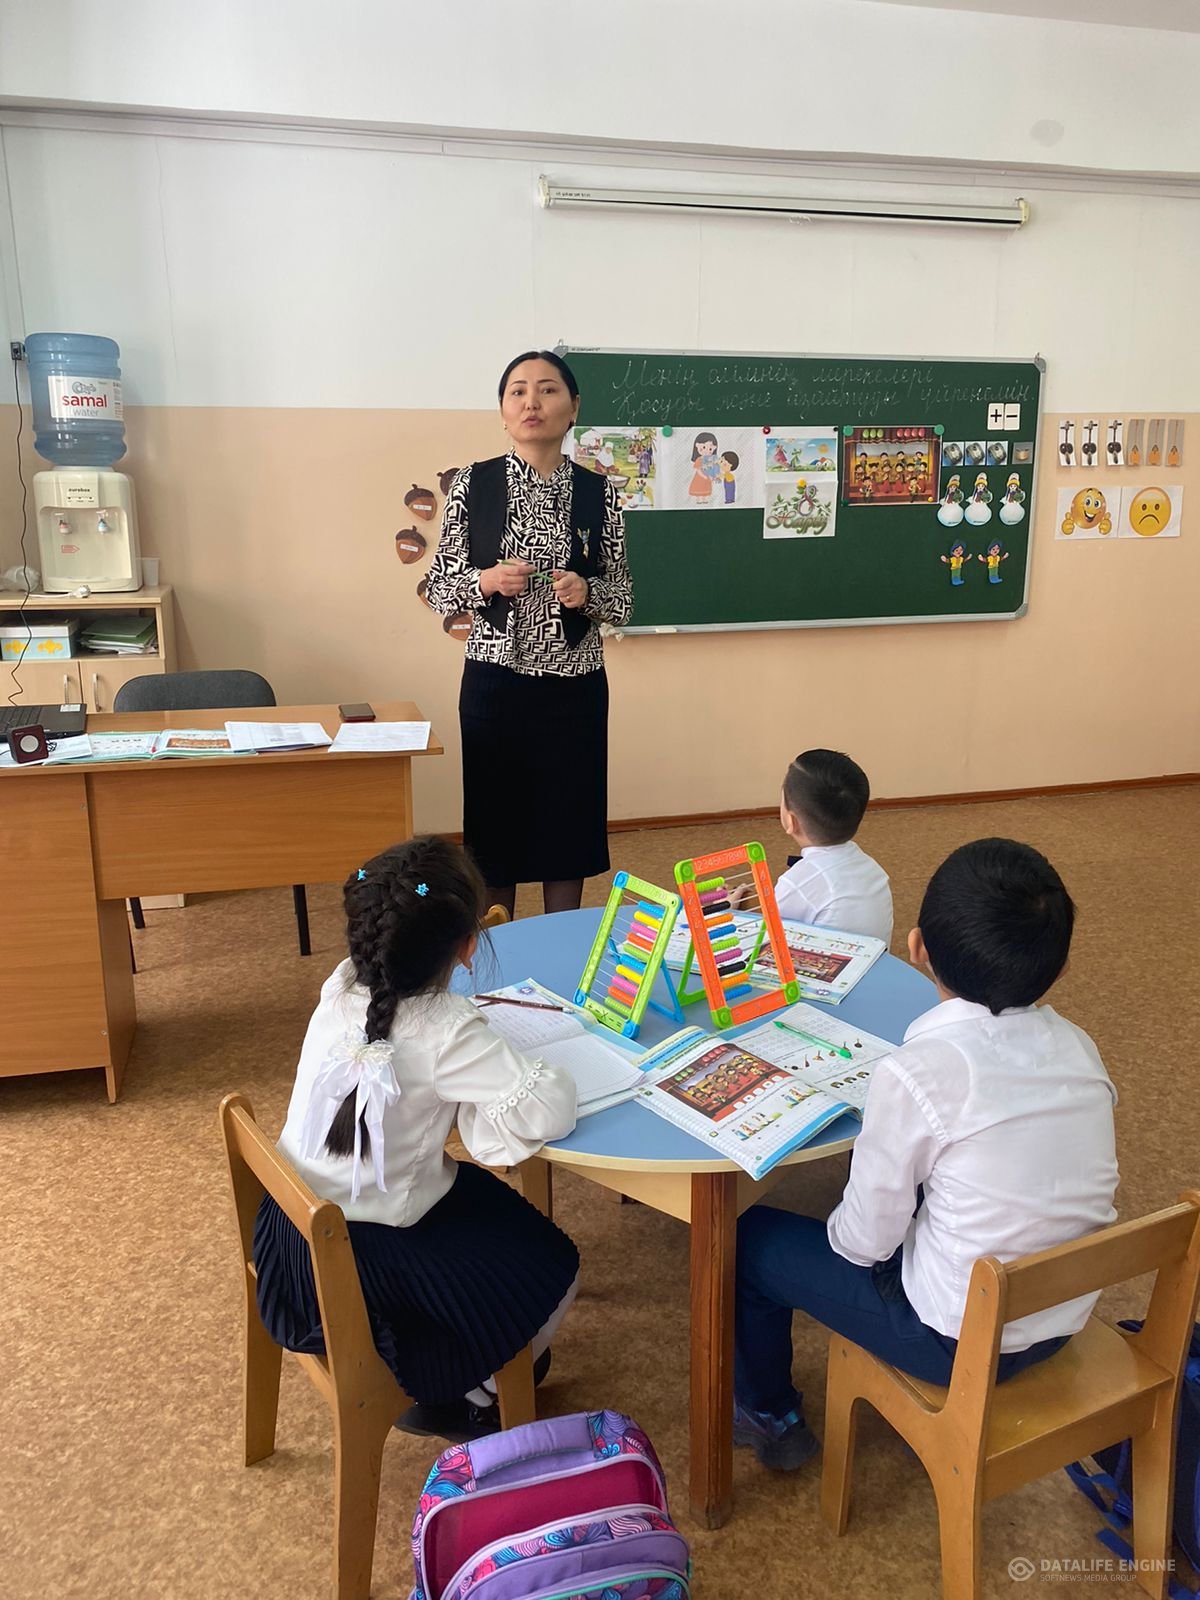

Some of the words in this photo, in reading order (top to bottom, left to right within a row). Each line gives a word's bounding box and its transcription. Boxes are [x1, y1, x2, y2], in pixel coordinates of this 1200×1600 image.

[612, 360, 699, 395] Менің
[62, 394, 107, 408] samal
[73, 408, 99, 416] water
